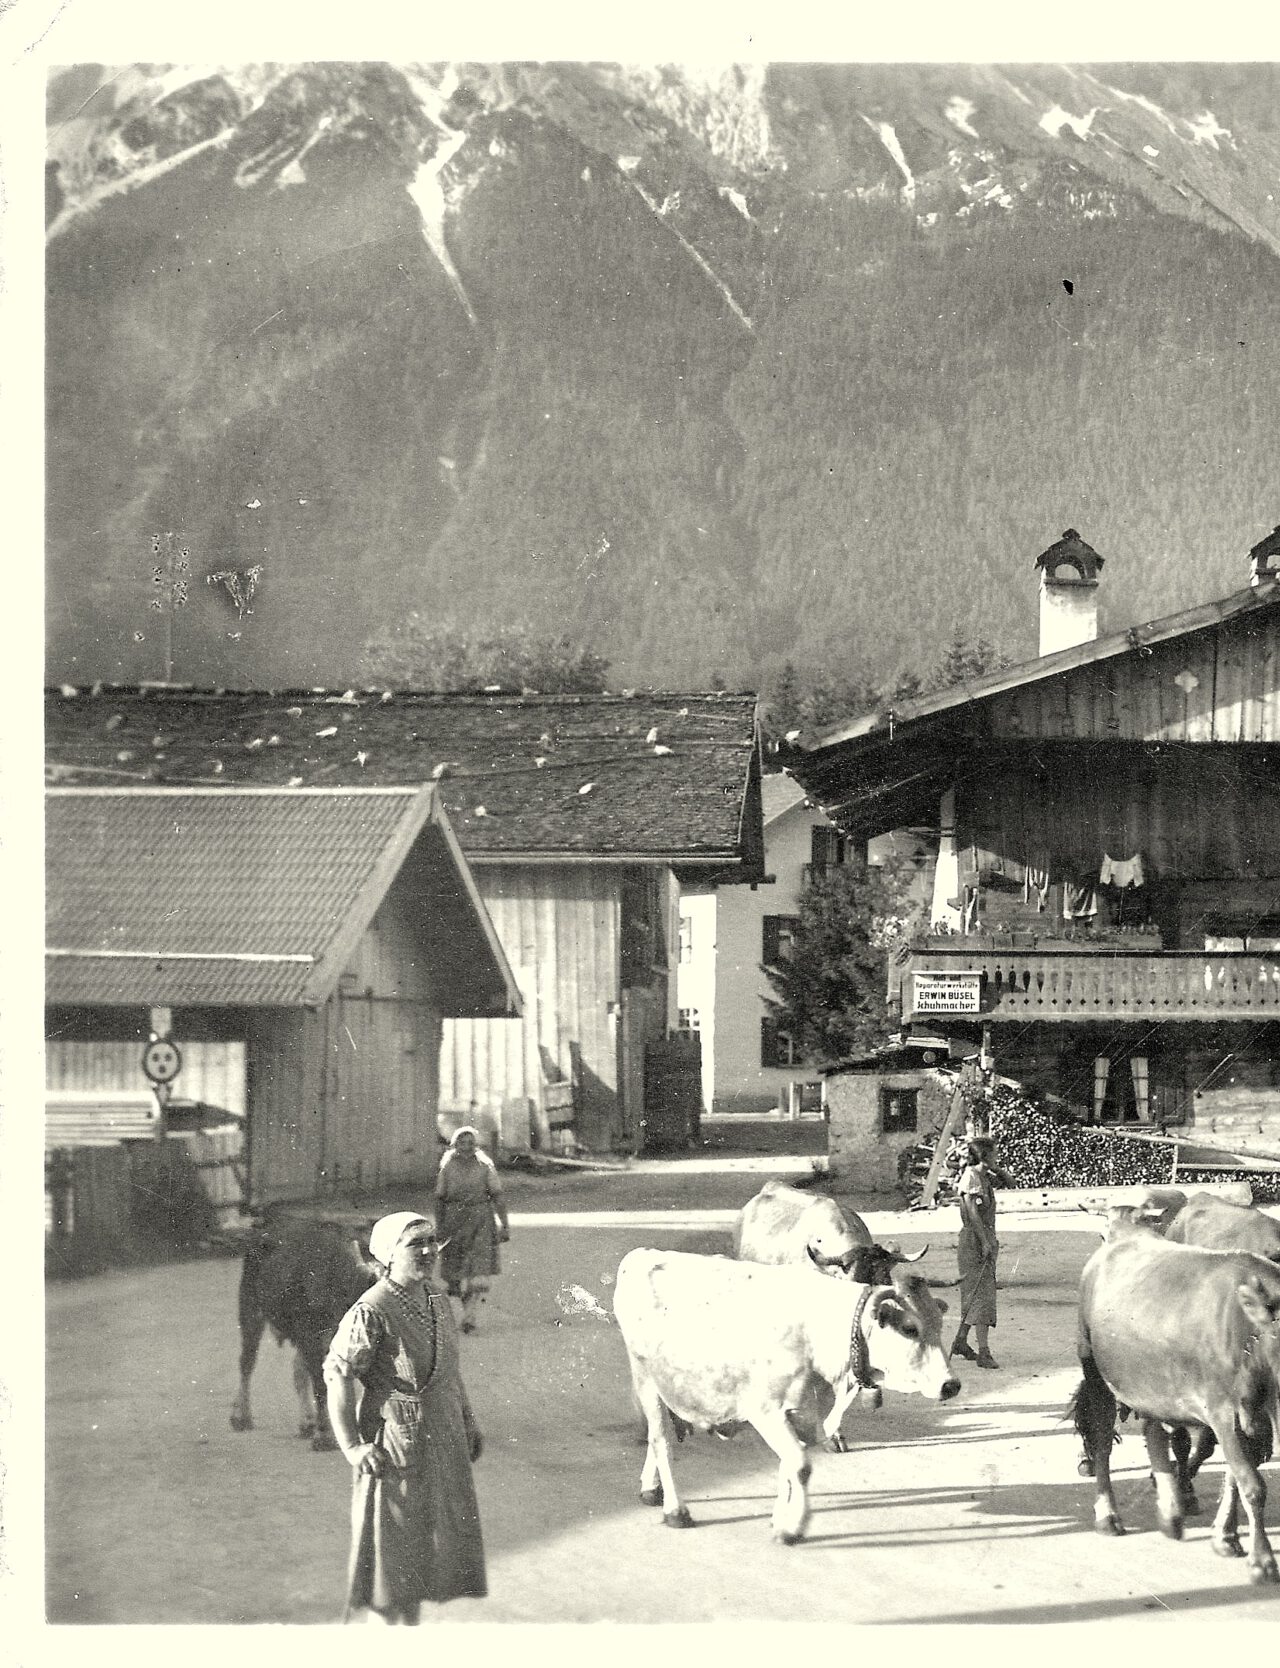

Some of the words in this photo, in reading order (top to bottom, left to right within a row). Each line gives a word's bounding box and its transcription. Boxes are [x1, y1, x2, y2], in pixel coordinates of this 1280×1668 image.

[919, 991, 946, 1000] ERWIN
[948, 989, 975, 1000] BÜSEL
[917, 1000, 976, 1010] Schuhmacher
